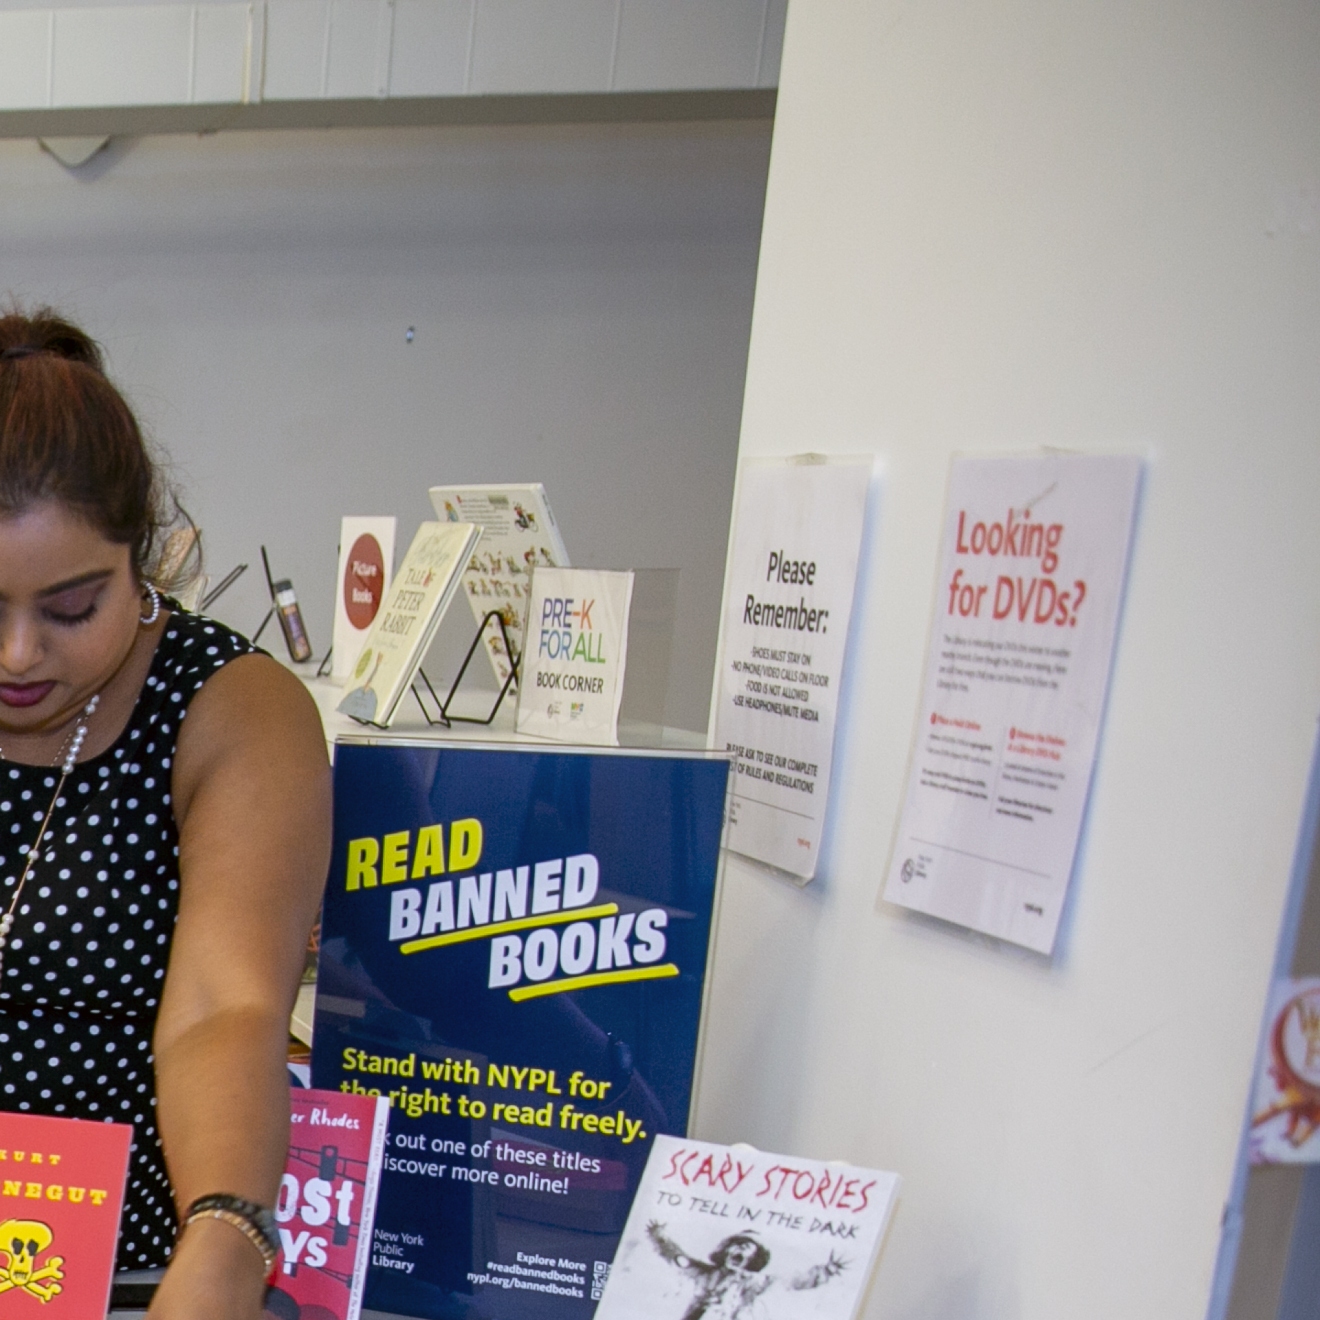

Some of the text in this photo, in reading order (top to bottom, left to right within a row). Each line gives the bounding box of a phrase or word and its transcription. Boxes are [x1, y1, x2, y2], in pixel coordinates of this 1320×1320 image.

[956, 508, 1064, 574] Looking
[766, 549, 816, 587] Please
[542, 597, 596, 630] PRE-K
[743, 594, 829, 634] Remember:
[948, 569, 1087, 628] for DVDs?
[538, 629, 607, 664] FOR ALL
[536, 671, 604, 694] BOOK CORNER
[346, 818, 483, 892] READ
[388, 853, 600, 942] BANNED
[488, 908, 669, 989] BOOKS
[342, 1046, 612, 1099] Stand with NYPL for
[310, 1107, 360, 1130] Rhodes
[389, 1086, 648, 1144] right to read freely.
[395, 1133, 601, 1173] out one of these titles
[451, 1167, 569, 1195] more online!
[662, 1148, 878, 1214] SCARY STORIES
[657, 1189, 861, 1241] TO TELL IN THE DARK
[373, 1242, 405, 1257] Public
[374, 1229, 425, 1246] New York
[372, 1255, 415, 1273] Library
[487, 1260, 586, 1285] #readbannedbooks
[516, 1251, 587, 1272] Explore More
